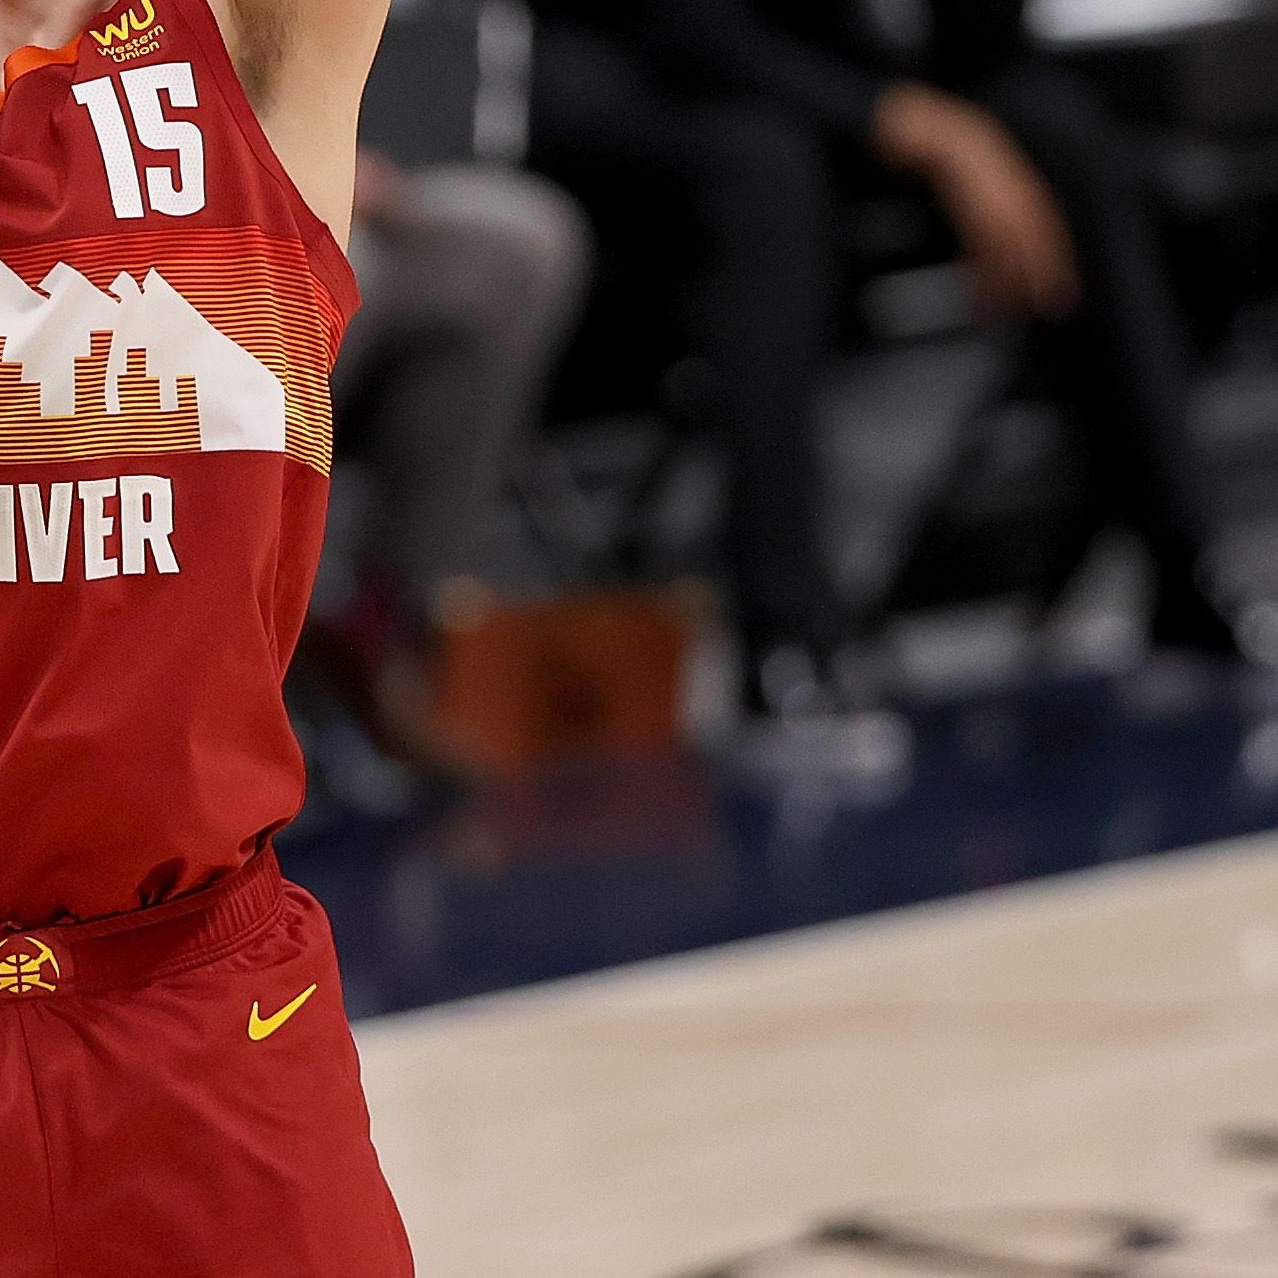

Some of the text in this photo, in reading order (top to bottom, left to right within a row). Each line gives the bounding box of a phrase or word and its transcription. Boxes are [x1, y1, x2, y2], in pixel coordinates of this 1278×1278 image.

[97, 25, 164, 56] Western
[113, 41, 160, 63] Union
[70, 62, 206, 219] 15
